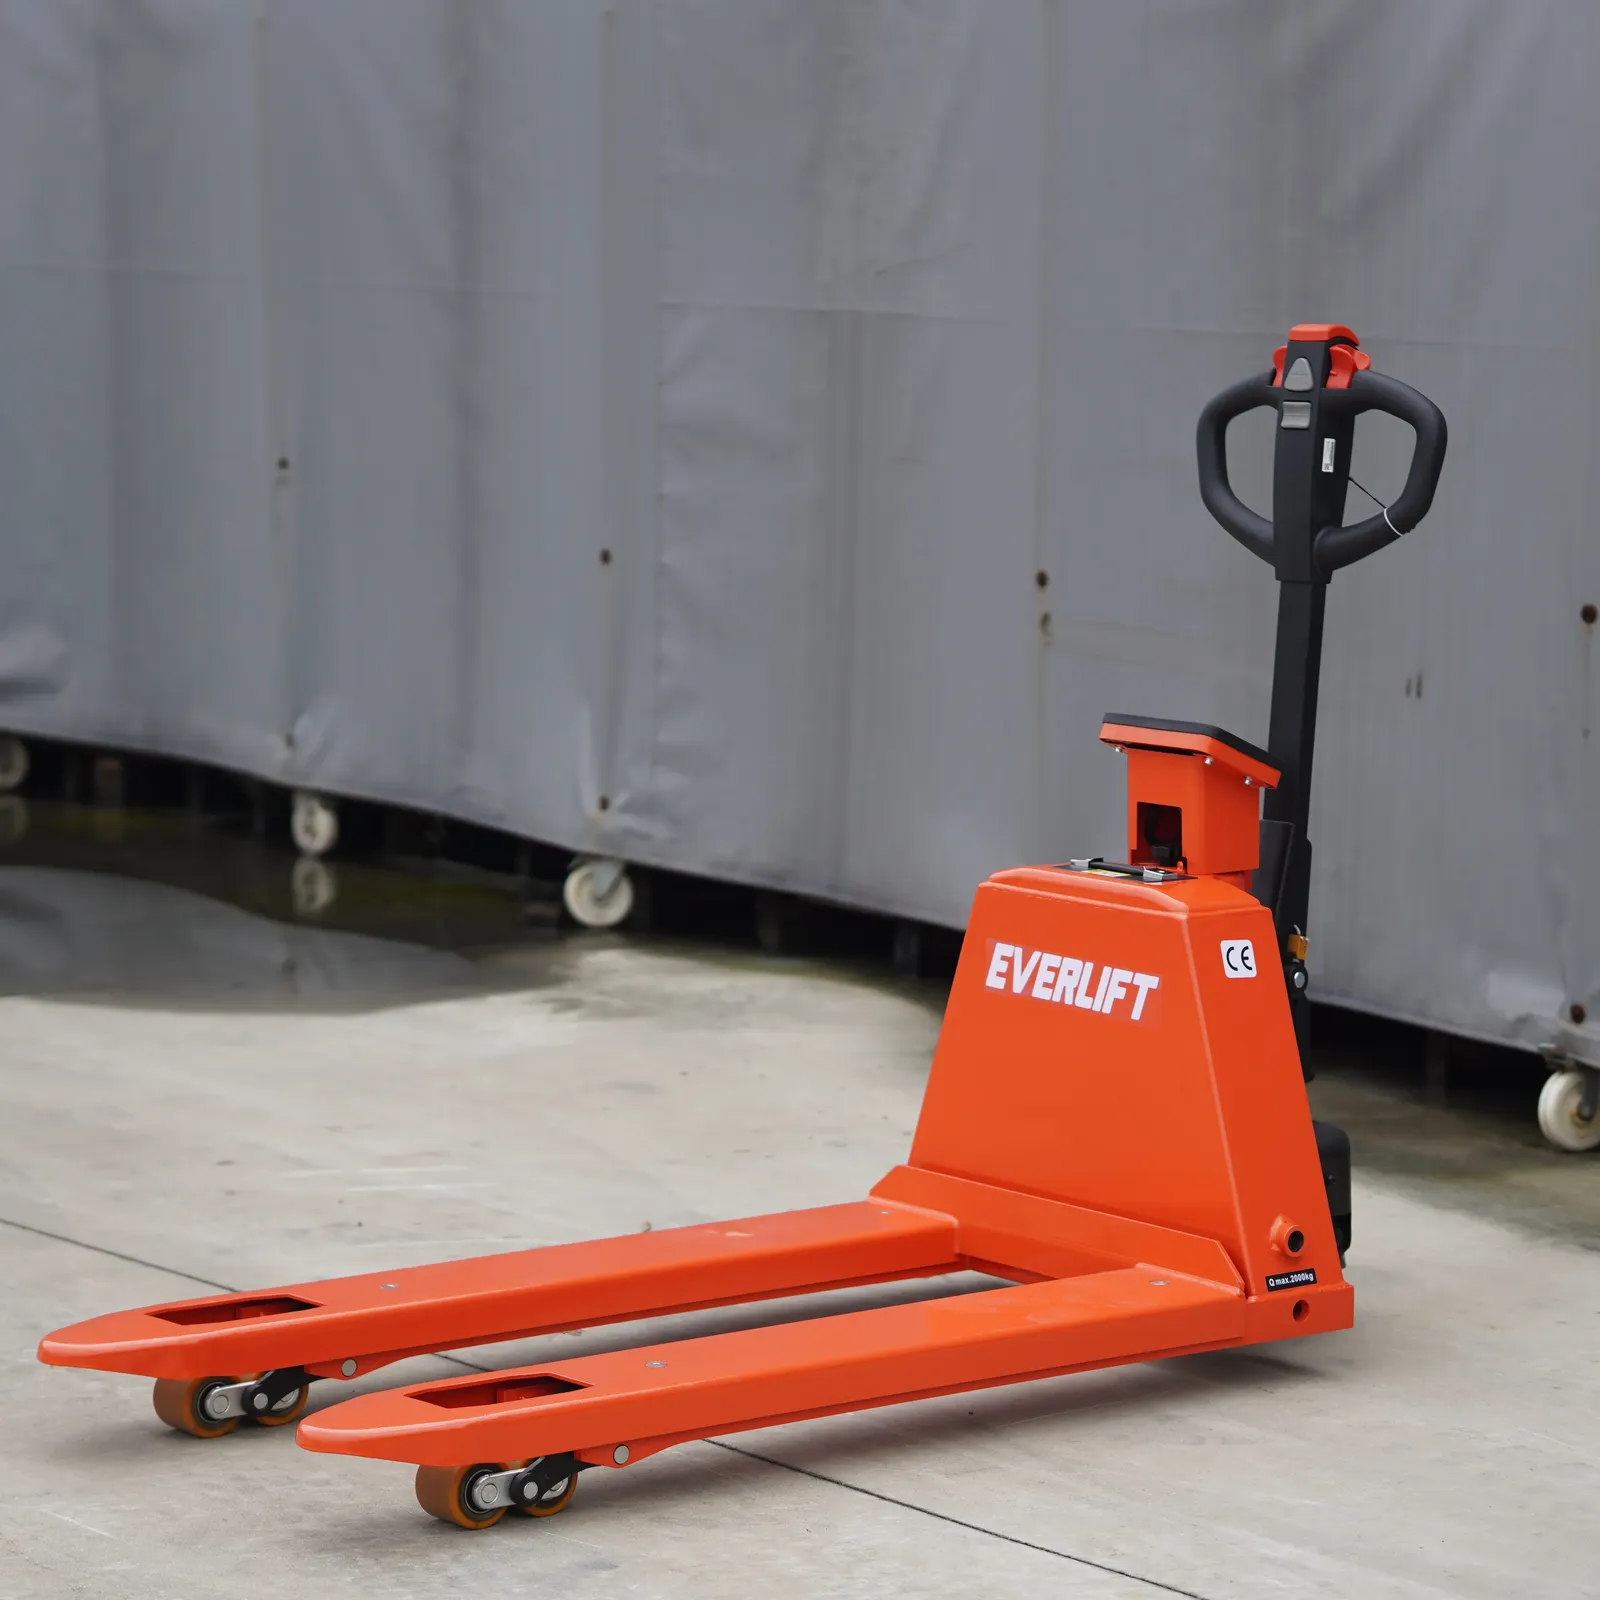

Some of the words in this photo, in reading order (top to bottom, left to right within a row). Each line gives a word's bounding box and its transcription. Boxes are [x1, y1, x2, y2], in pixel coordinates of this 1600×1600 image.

[1226, 945, 1253, 972] CE
[985, 942, 1160, 1021] EVERLIFT
[1268, 1278, 1275, 1287] Q
